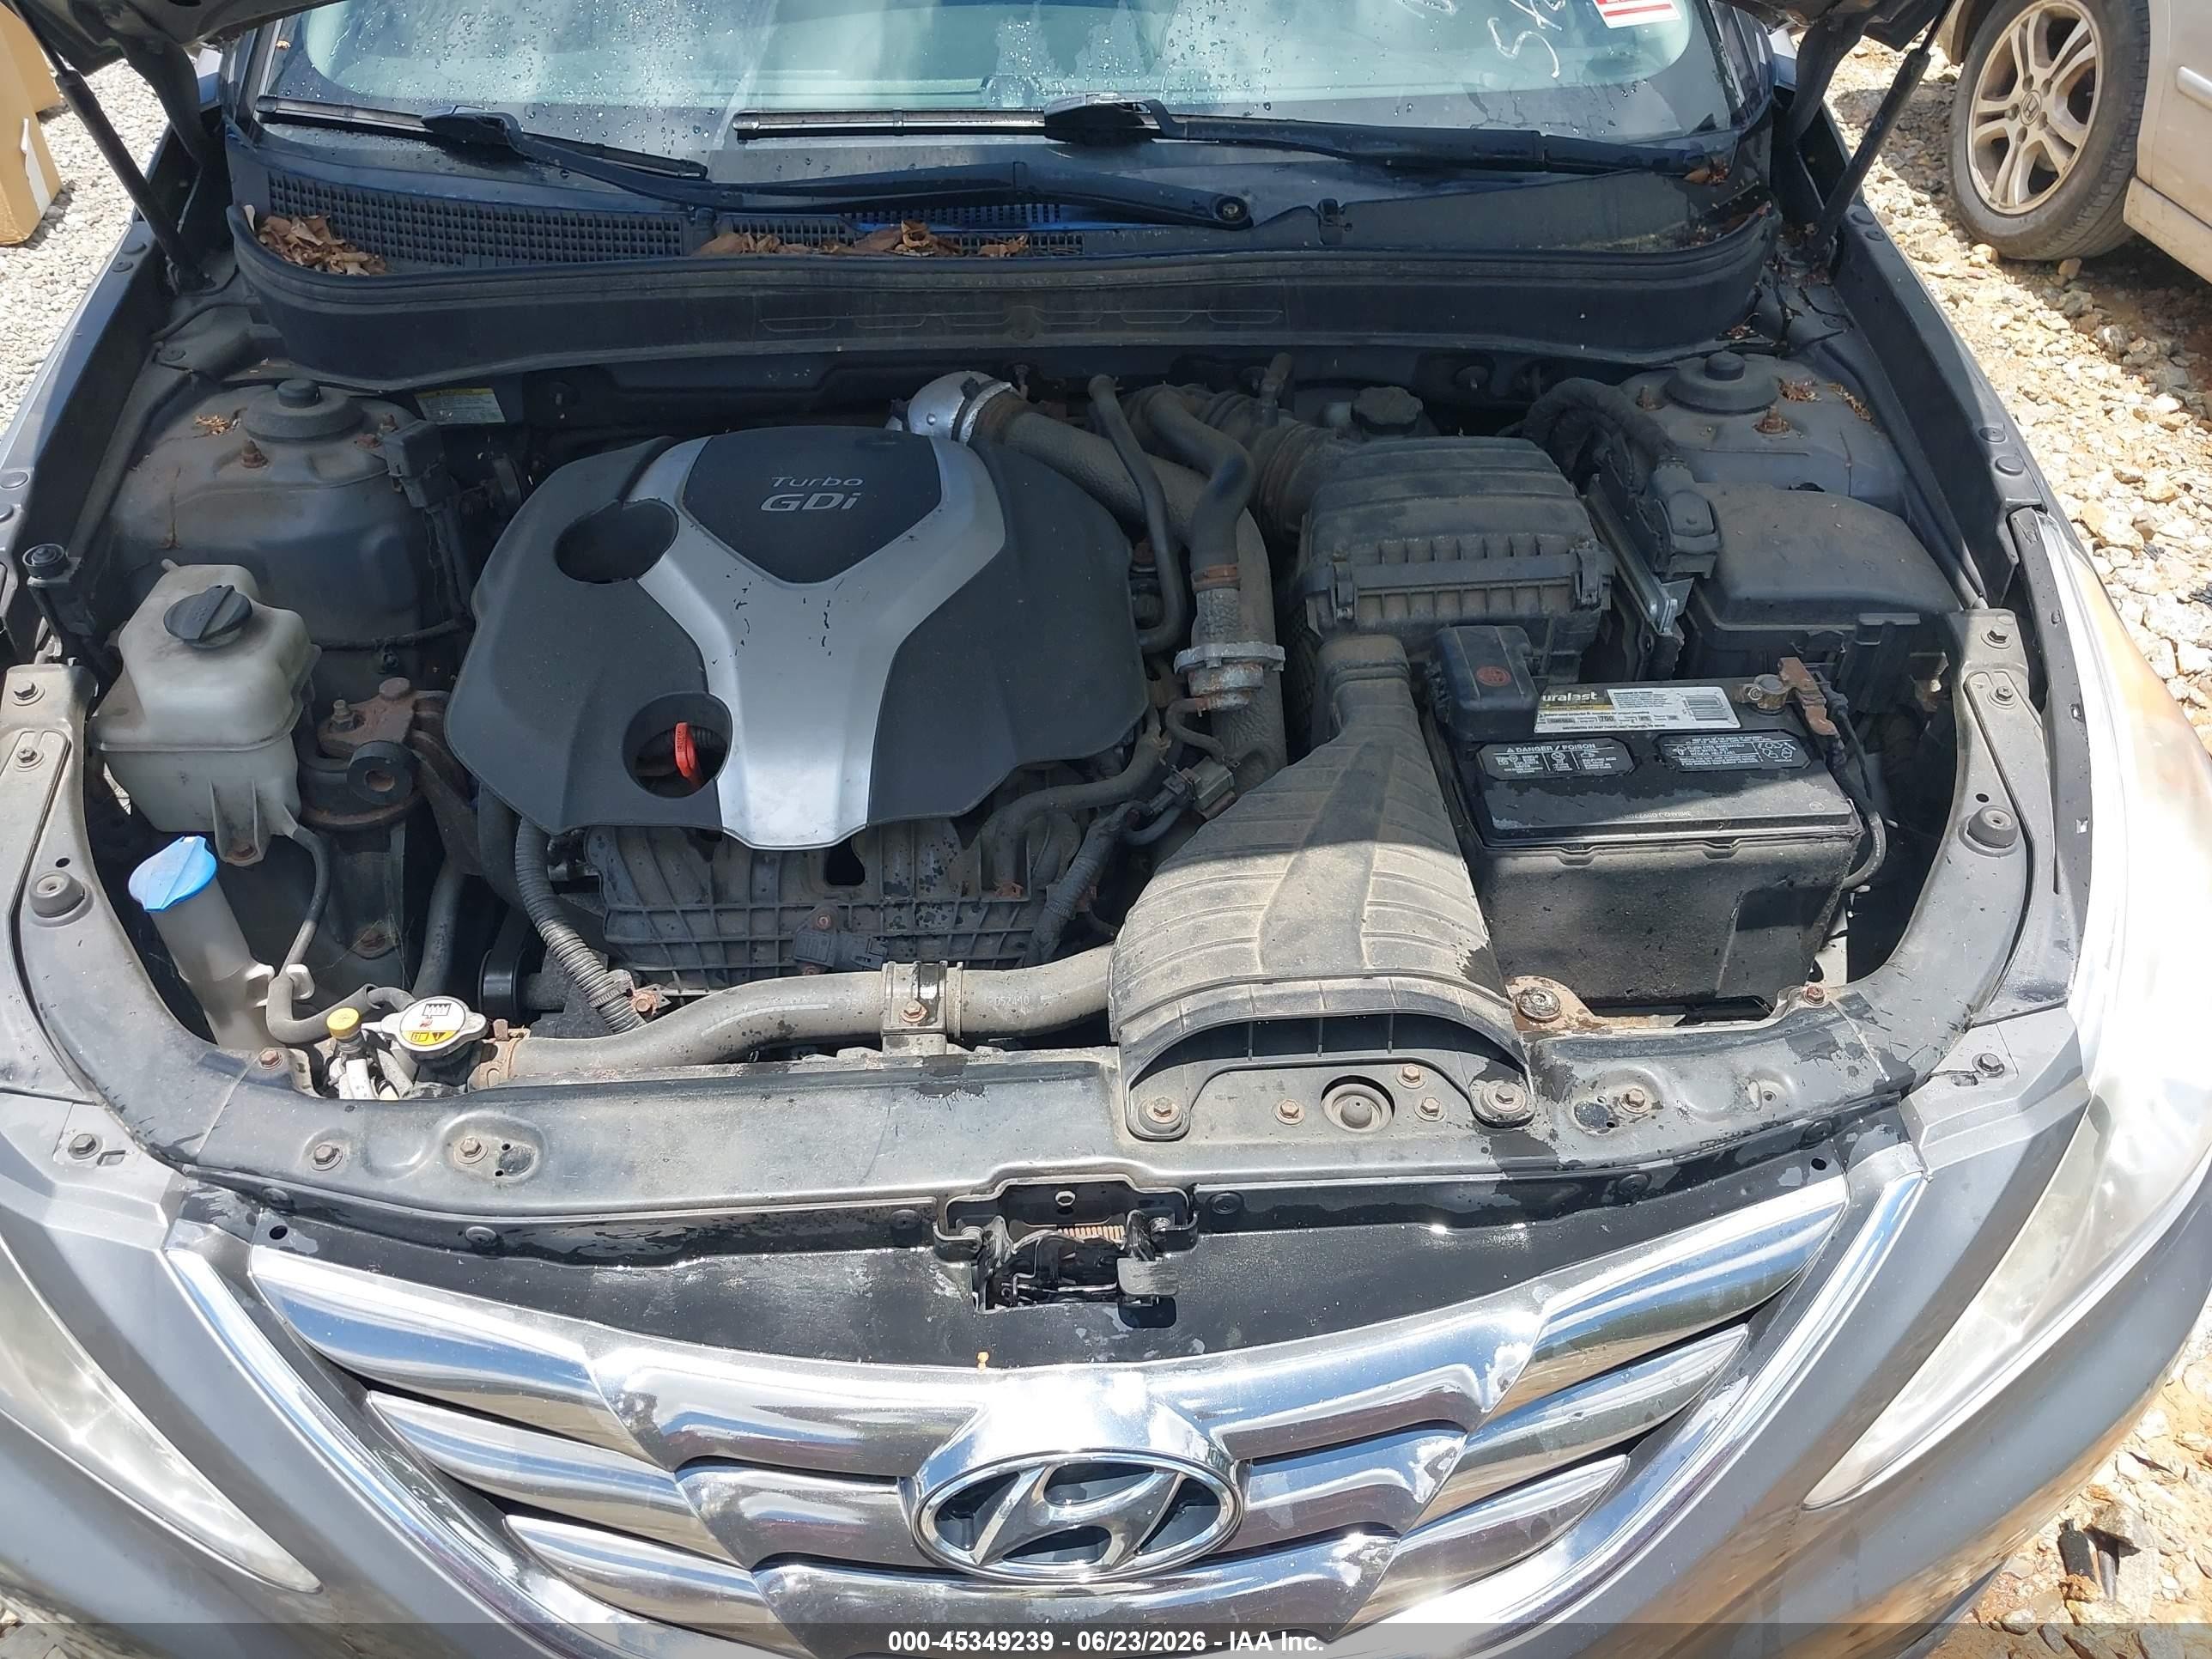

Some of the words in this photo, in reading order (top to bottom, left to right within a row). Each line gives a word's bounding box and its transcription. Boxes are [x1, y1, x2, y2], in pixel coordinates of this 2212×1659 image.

[772, 477, 863, 487] Turbo
[761, 493, 861, 511] GDi
[1540, 691, 1597, 702] uralast
